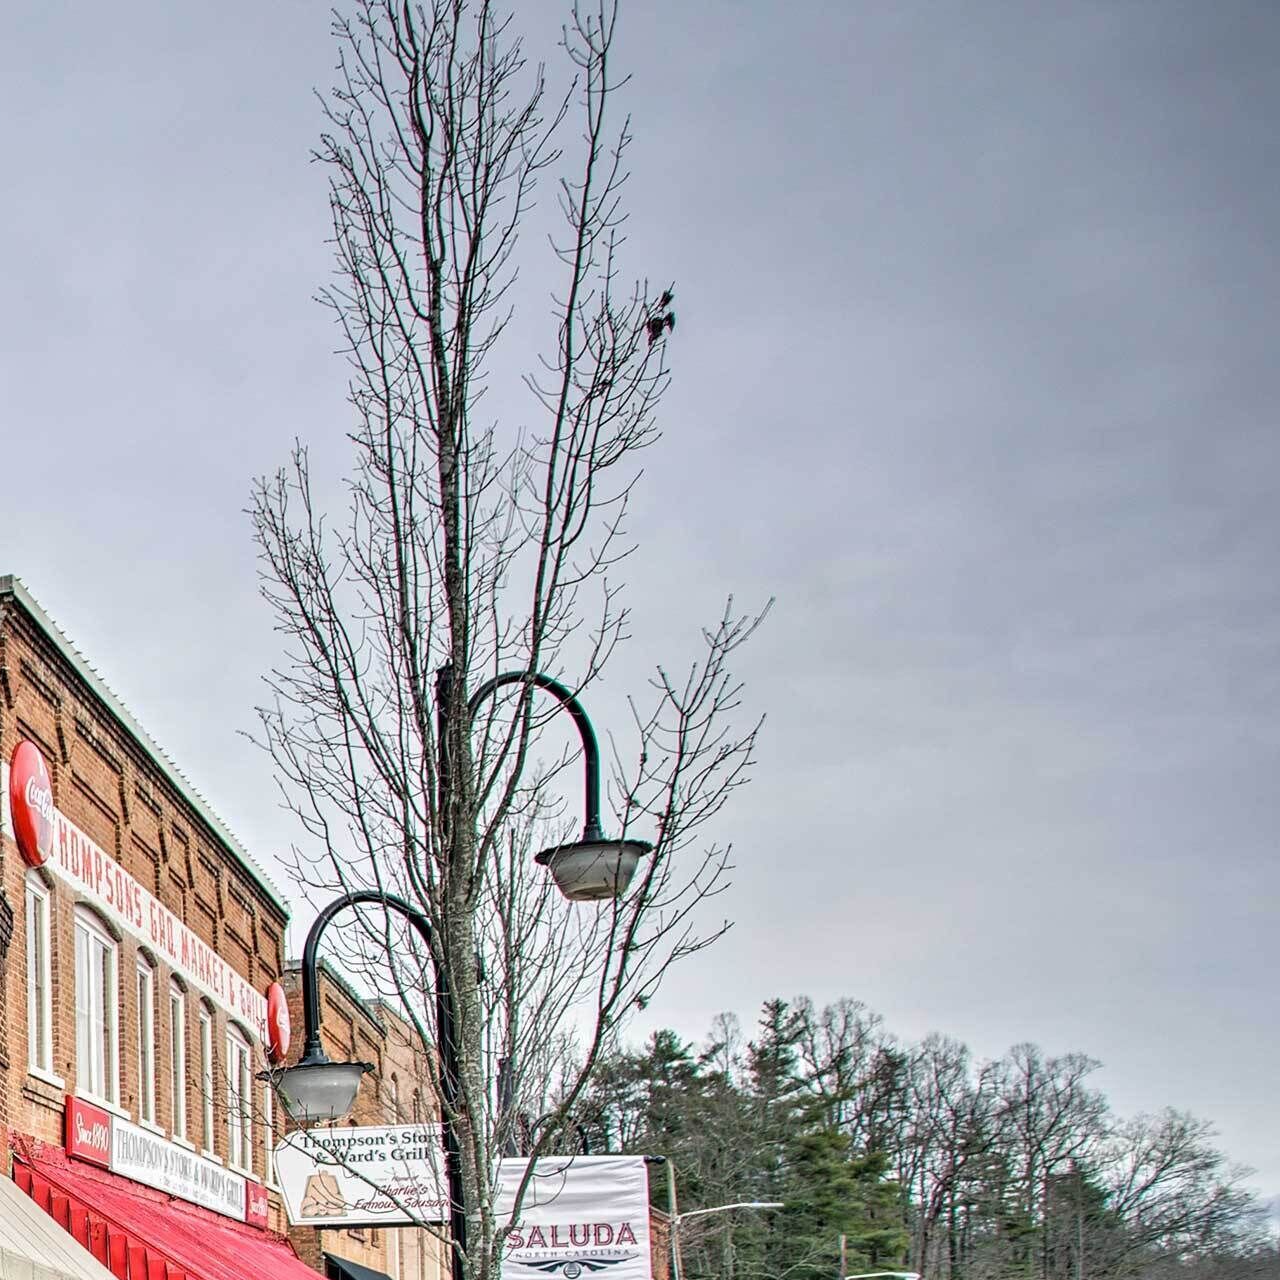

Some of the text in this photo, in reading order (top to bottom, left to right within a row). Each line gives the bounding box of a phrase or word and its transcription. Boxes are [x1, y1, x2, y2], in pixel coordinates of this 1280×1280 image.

[51, 815, 143, 929] HOMPSON'S
[181, 929, 225, 995] MARKET
[300, 1132, 399, 1150] Thompson's
[335, 1149, 387, 1164] Ward's
[391, 1147, 430, 1162] Grill
[506, 1222, 638, 1249] SALUDA
[515, 1249, 631, 1259] NORTH CAROLINA
